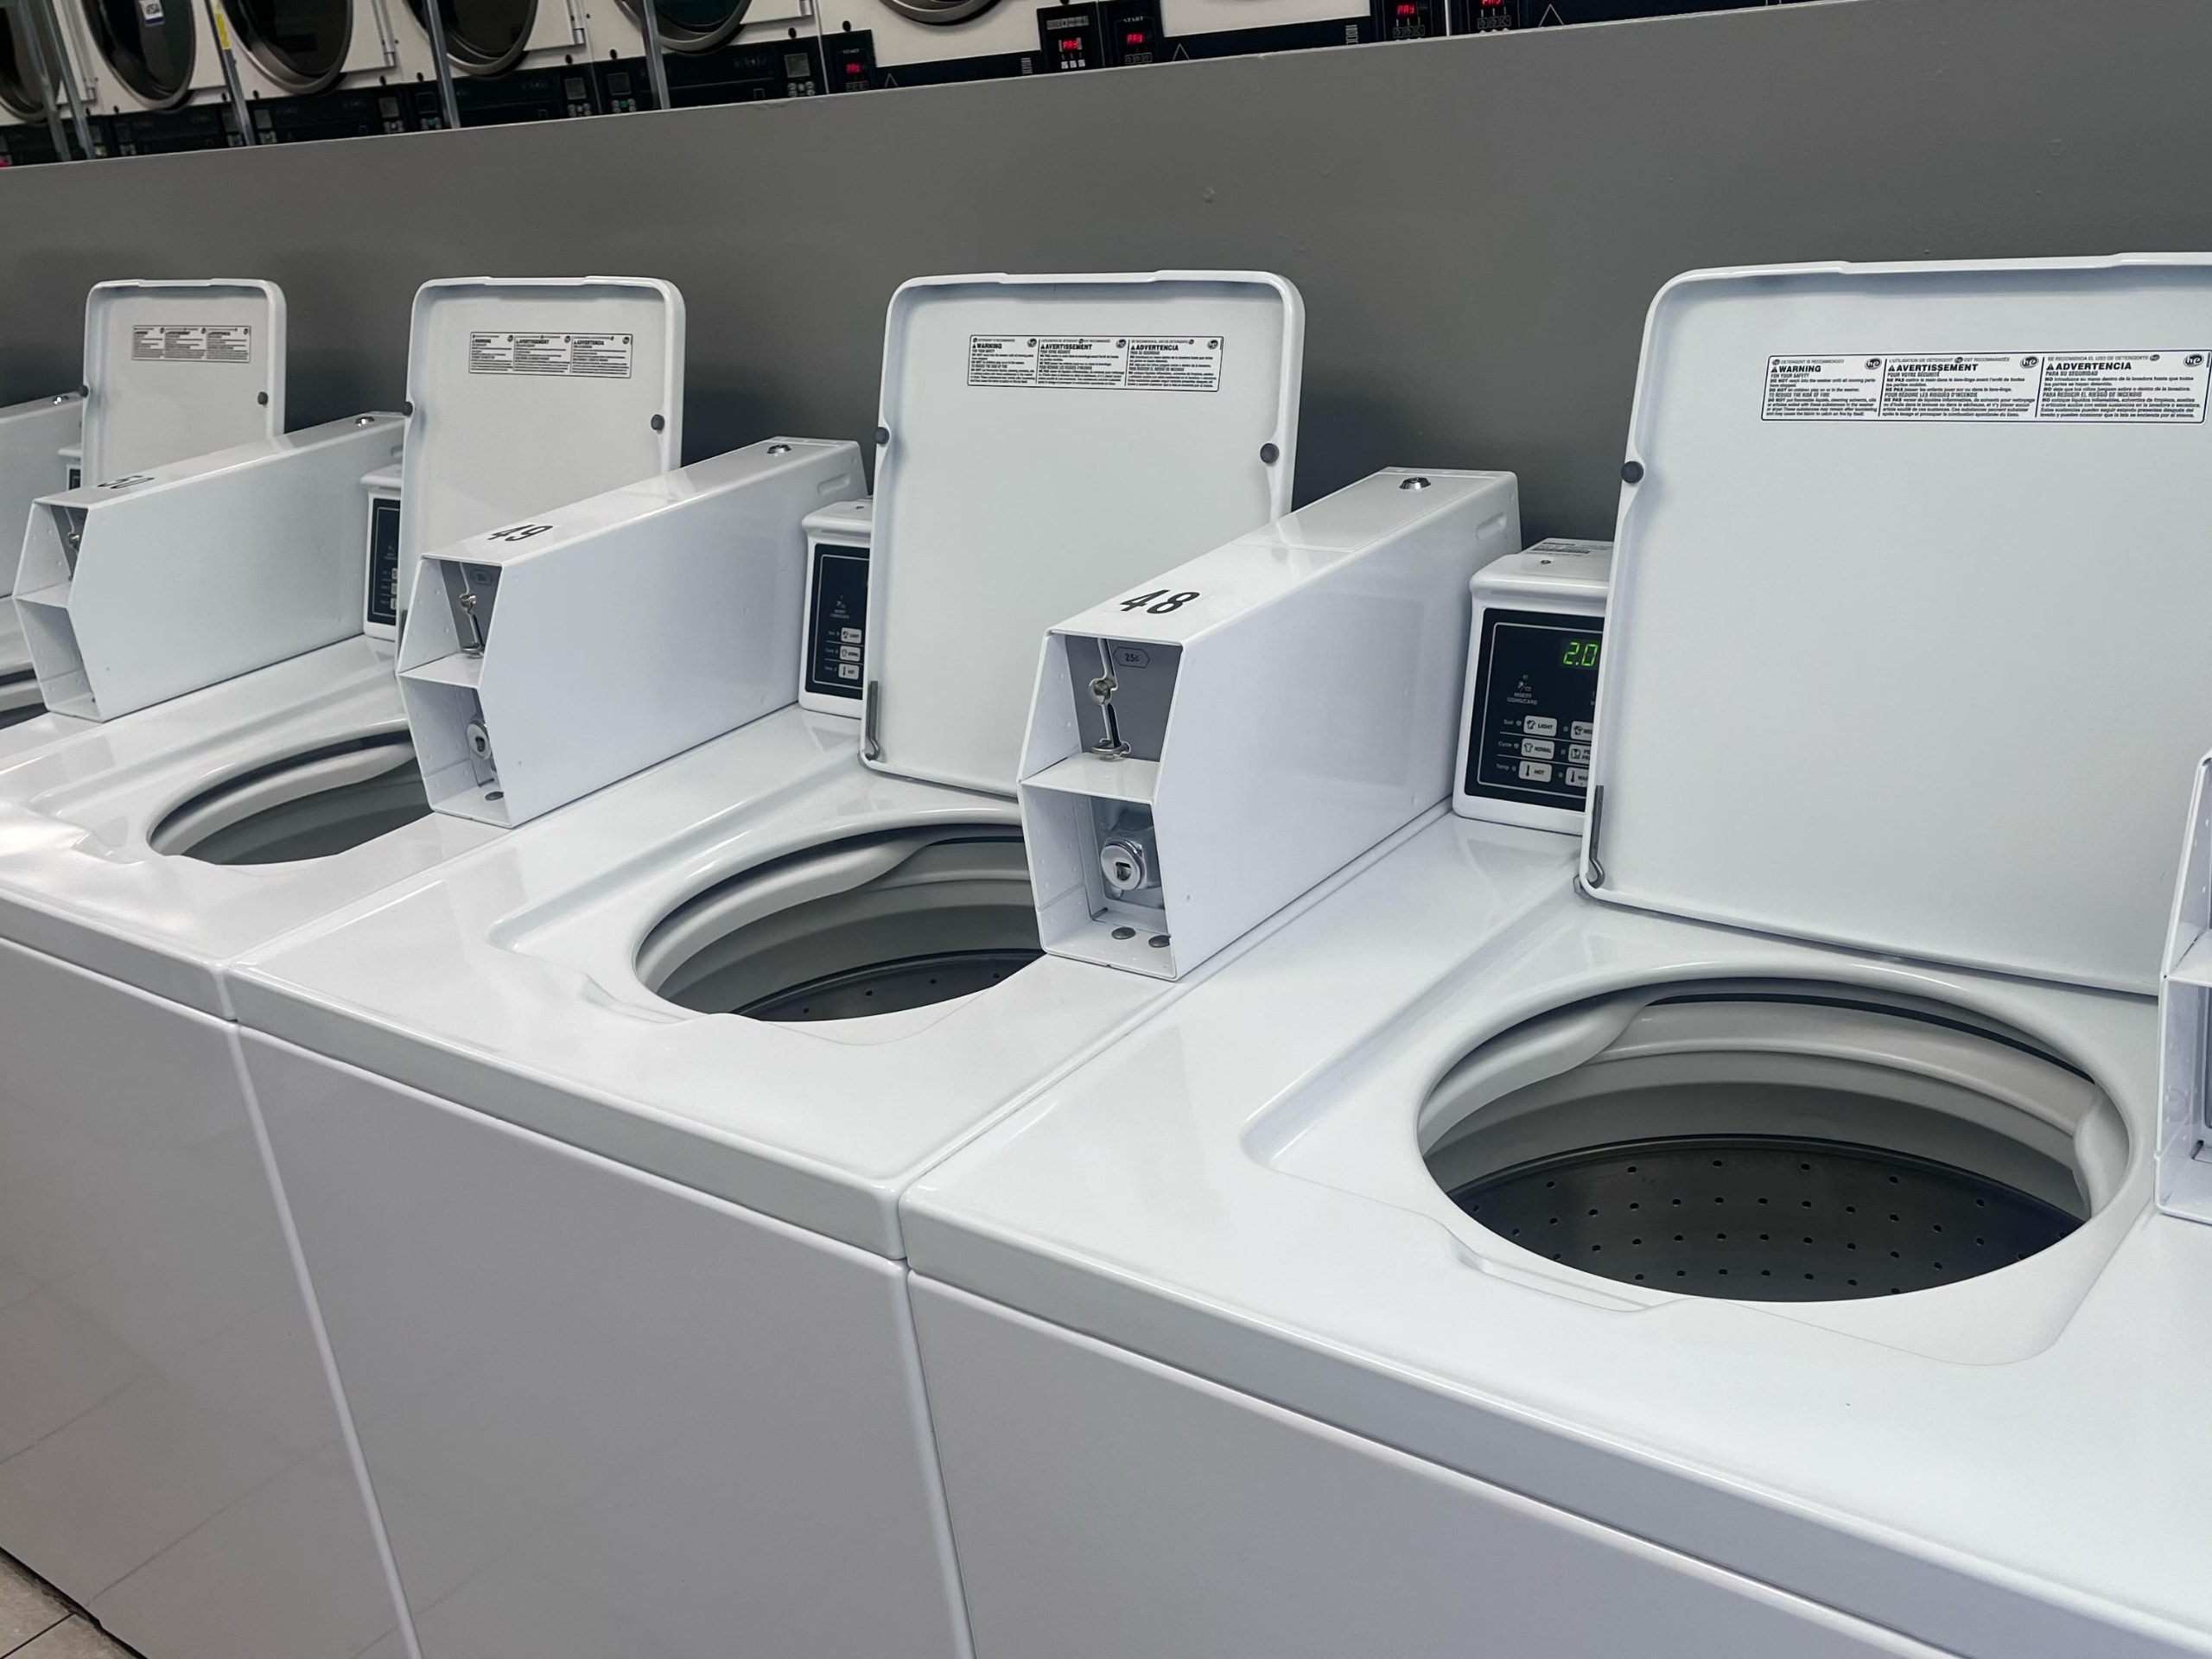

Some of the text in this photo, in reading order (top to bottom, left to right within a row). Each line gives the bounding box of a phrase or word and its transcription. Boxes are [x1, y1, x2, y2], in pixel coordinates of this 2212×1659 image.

[486, 524, 554, 542] 49
[1119, 589, 1200, 614] 48
[1563, 642, 1599, 666] 2.0
